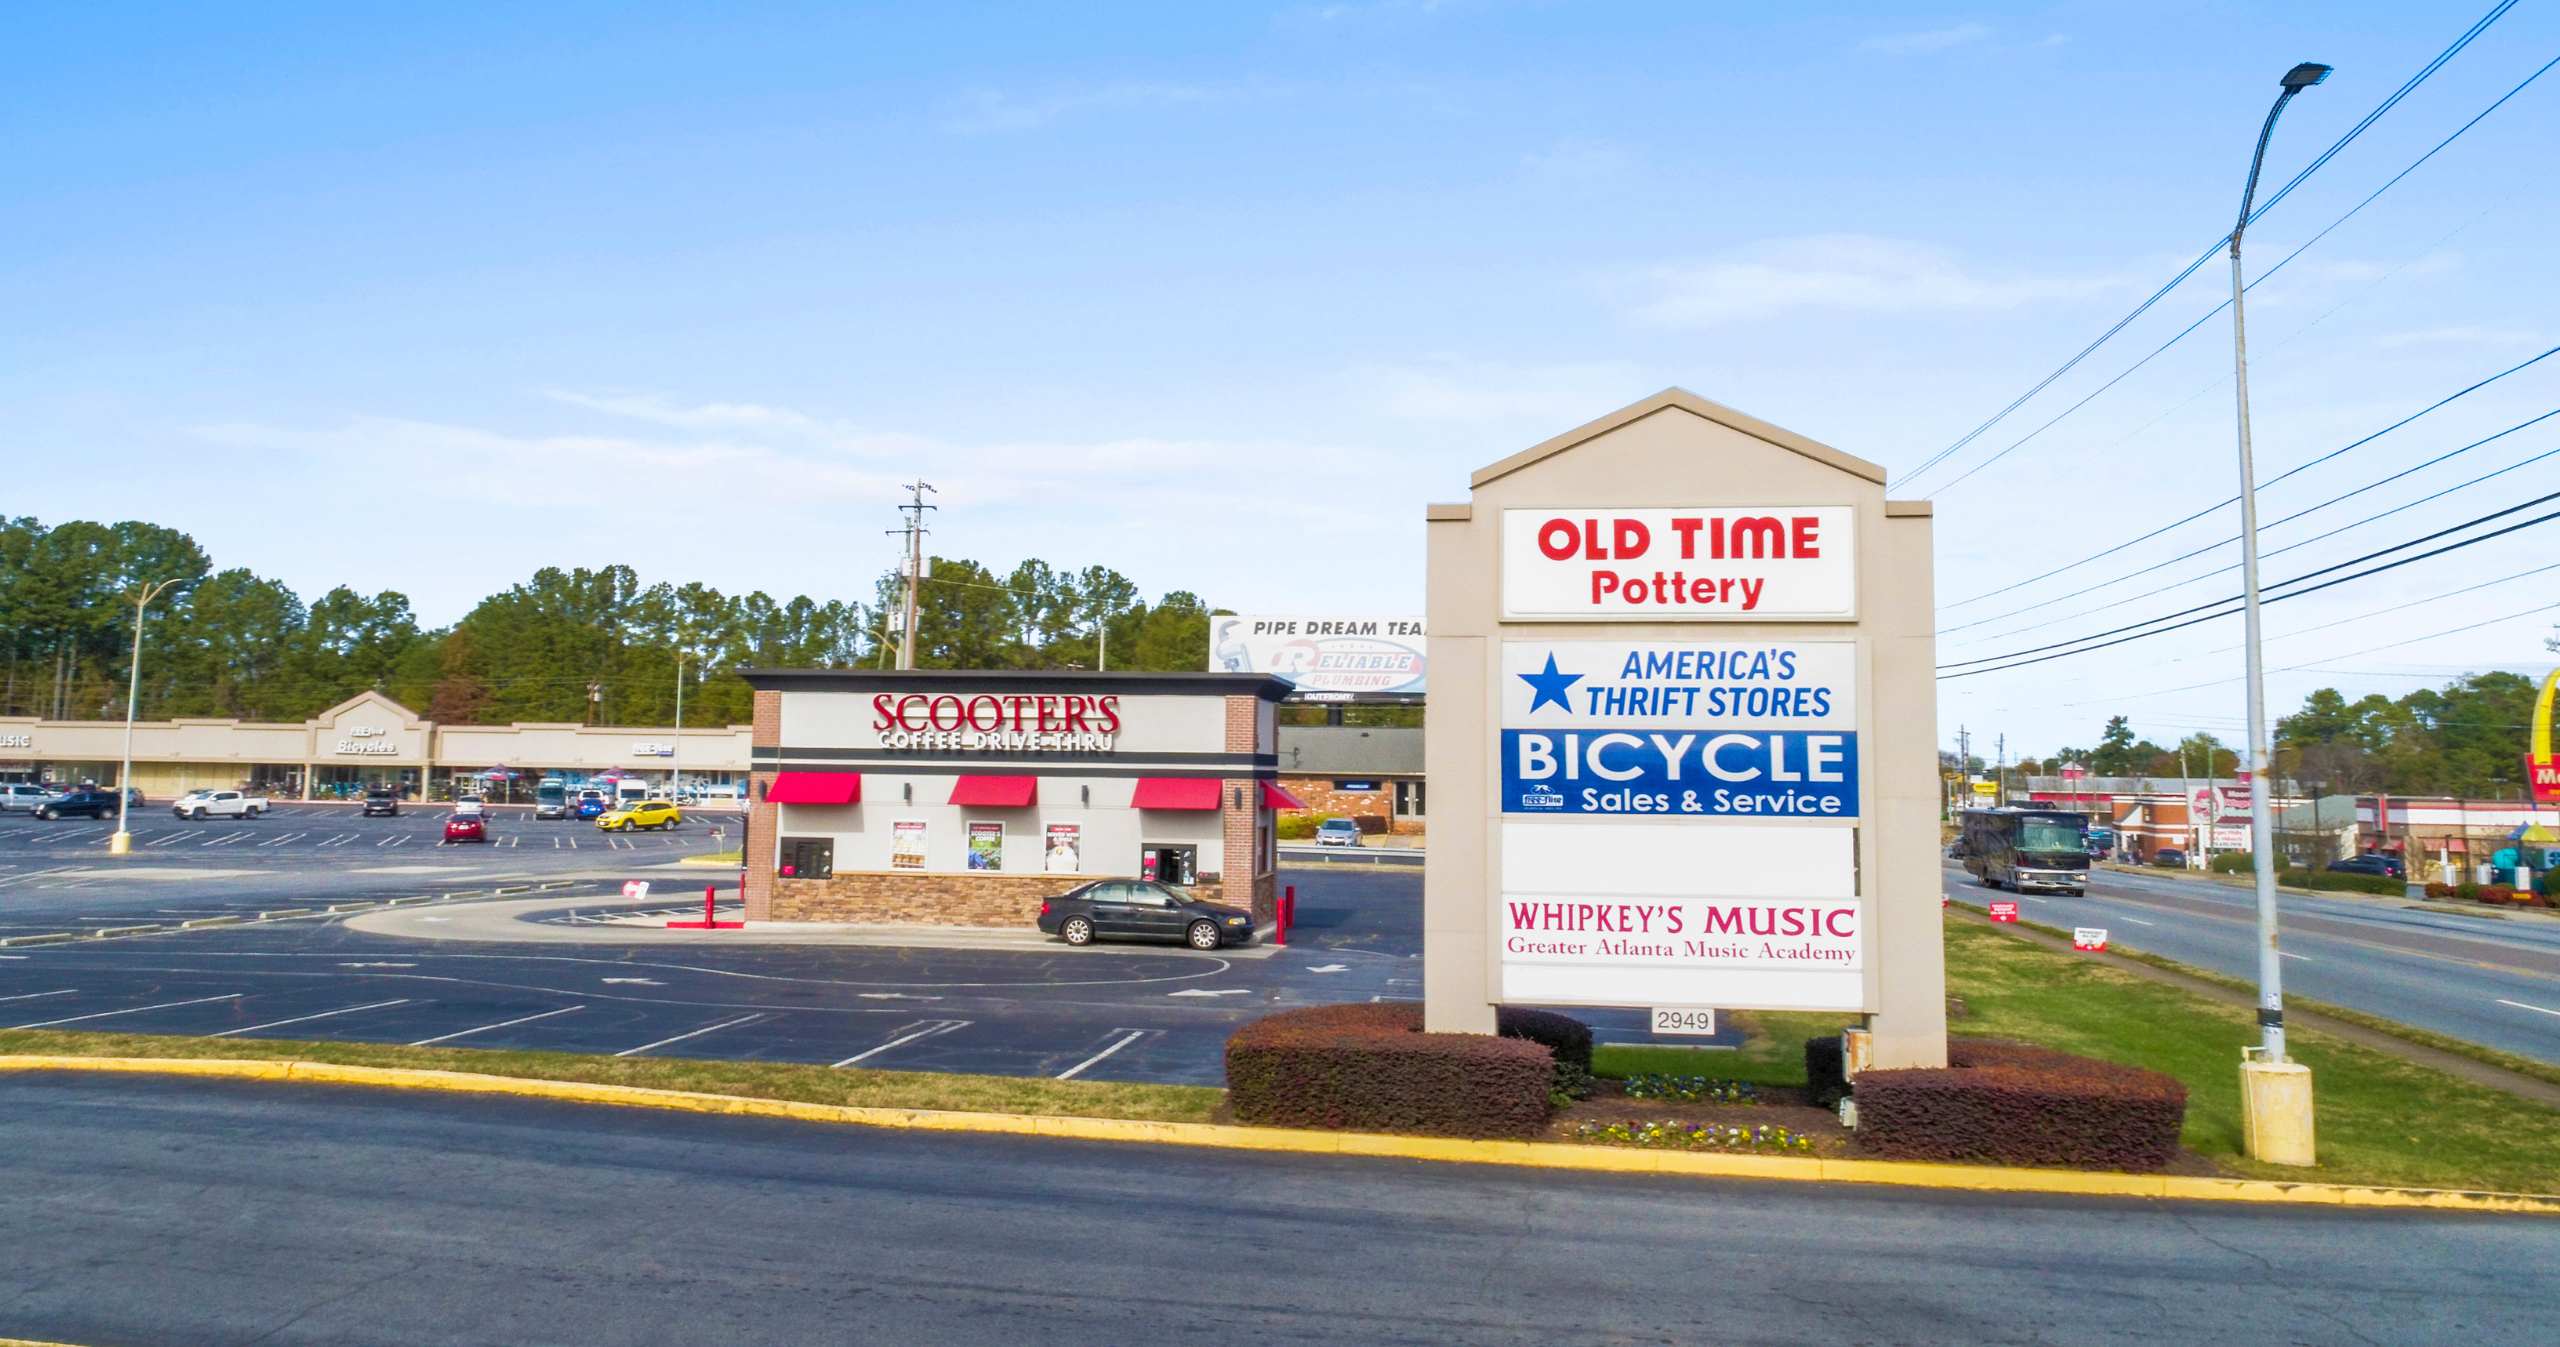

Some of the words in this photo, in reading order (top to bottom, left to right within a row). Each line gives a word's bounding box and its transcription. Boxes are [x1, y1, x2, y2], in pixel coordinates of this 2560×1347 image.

[1538, 519, 1650, 561] OLD
[1671, 516, 1820, 559] TIME
[1592, 570, 1765, 610] Pottery
[1254, 622, 1296, 635] PIPE
[1306, 622, 1377, 635] DREAM
[1388, 622, 1426, 635] TEA
[1621, 648, 1796, 680] AMERICA'S
[1311, 675, 1392, 686] PLUMBING
[872, 693, 1121, 733] SCOOTER'S
[1586, 687, 1700, 716] THRIFT
[1707, 687, 1832, 717] STORES
[879, 732, 962, 750] COFFEE
[1518, 733, 1843, 782] BICYCLE
[1582, 788, 1669, 812] Sales
[1682, 791, 1703, 812] &
[1713, 790, 1841, 813] Service
[1509, 903, 1683, 933] WHIPKEY'S
[1703, 906, 1855, 937] MUSIC
[1508, 936, 1587, 954] Greater
[1596, 938, 1674, 957] Atlanta
[1684, 940, 1749, 959] Music
[1759, 942, 1856, 965] Academy
[1658, 1012, 1709, 1030] 2949
